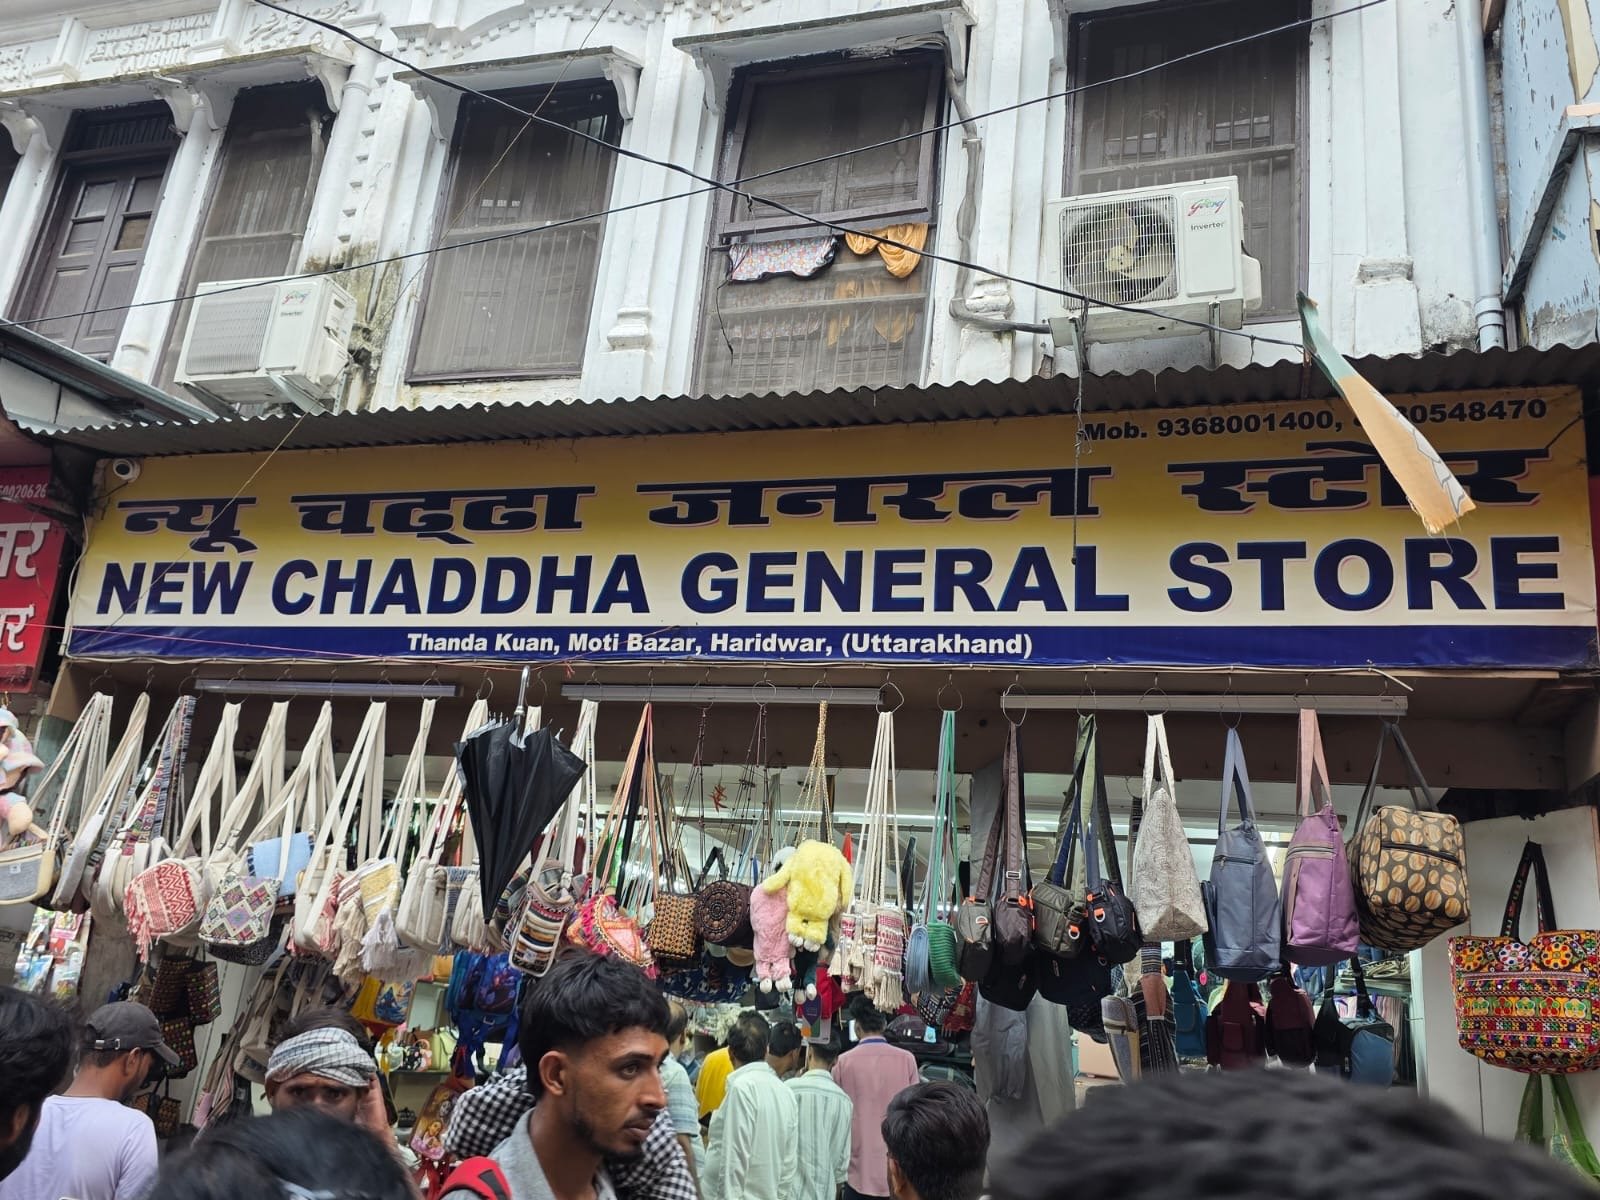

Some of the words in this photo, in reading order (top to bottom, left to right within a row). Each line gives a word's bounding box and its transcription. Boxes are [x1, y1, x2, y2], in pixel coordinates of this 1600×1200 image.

[1191, 222, 1224, 231] Inverter
[1085, 421, 1147, 440] Mob.
[1157, 410, 1342, 437] 9368001400,
[1353, 399, 1547, 427] 0548470
[118, 497, 258, 553] न्यू
[636, 466, 1112, 524] जनरल
[97, 561, 253, 614] NEW
[271, 554, 650, 614] CHADDHA
[681, 546, 1129, 613] GENERAL
[1167, 537, 1565, 612] STORE
[407, 633, 488, 652] Thanda
[495, 633, 559, 655] Kuan,
[568, 634, 619, 652] Moti
[627, 633, 702, 655] Bazar,
[710, 633, 832, 656] Haridwar,
[841, 633, 1033, 658] (Uttarakhand)
